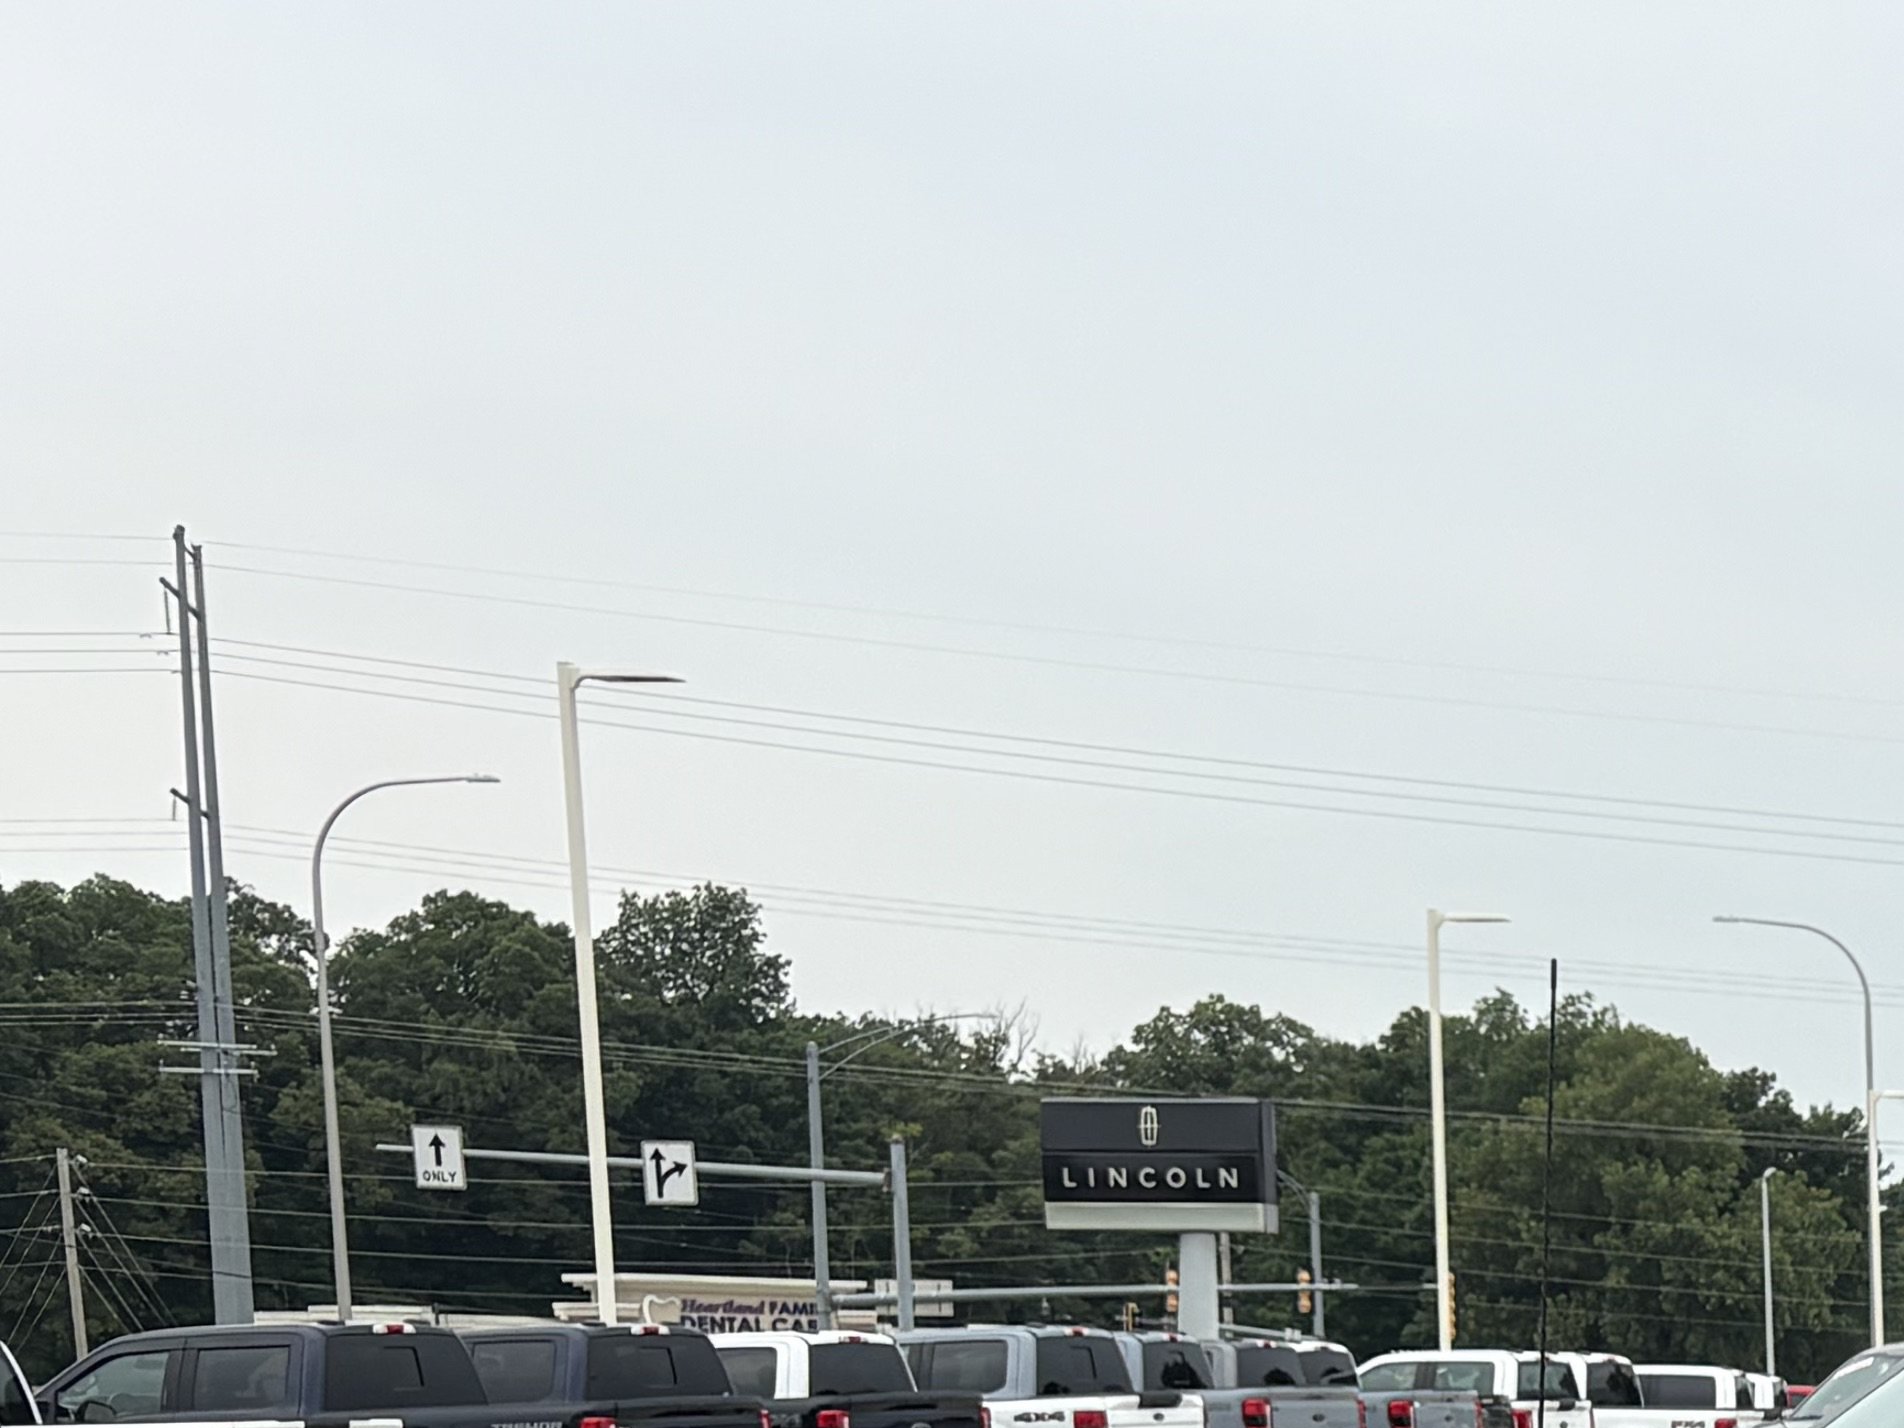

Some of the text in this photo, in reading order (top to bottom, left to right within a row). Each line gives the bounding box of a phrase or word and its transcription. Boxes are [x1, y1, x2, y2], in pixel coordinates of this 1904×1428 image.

[422, 1170, 457, 1183] ONLY
[1062, 1167, 1239, 1188] LINCOLN
[681, 1299, 818, 1316] Heartland FAMI
[681, 1316, 766, 1334] DENTAL
